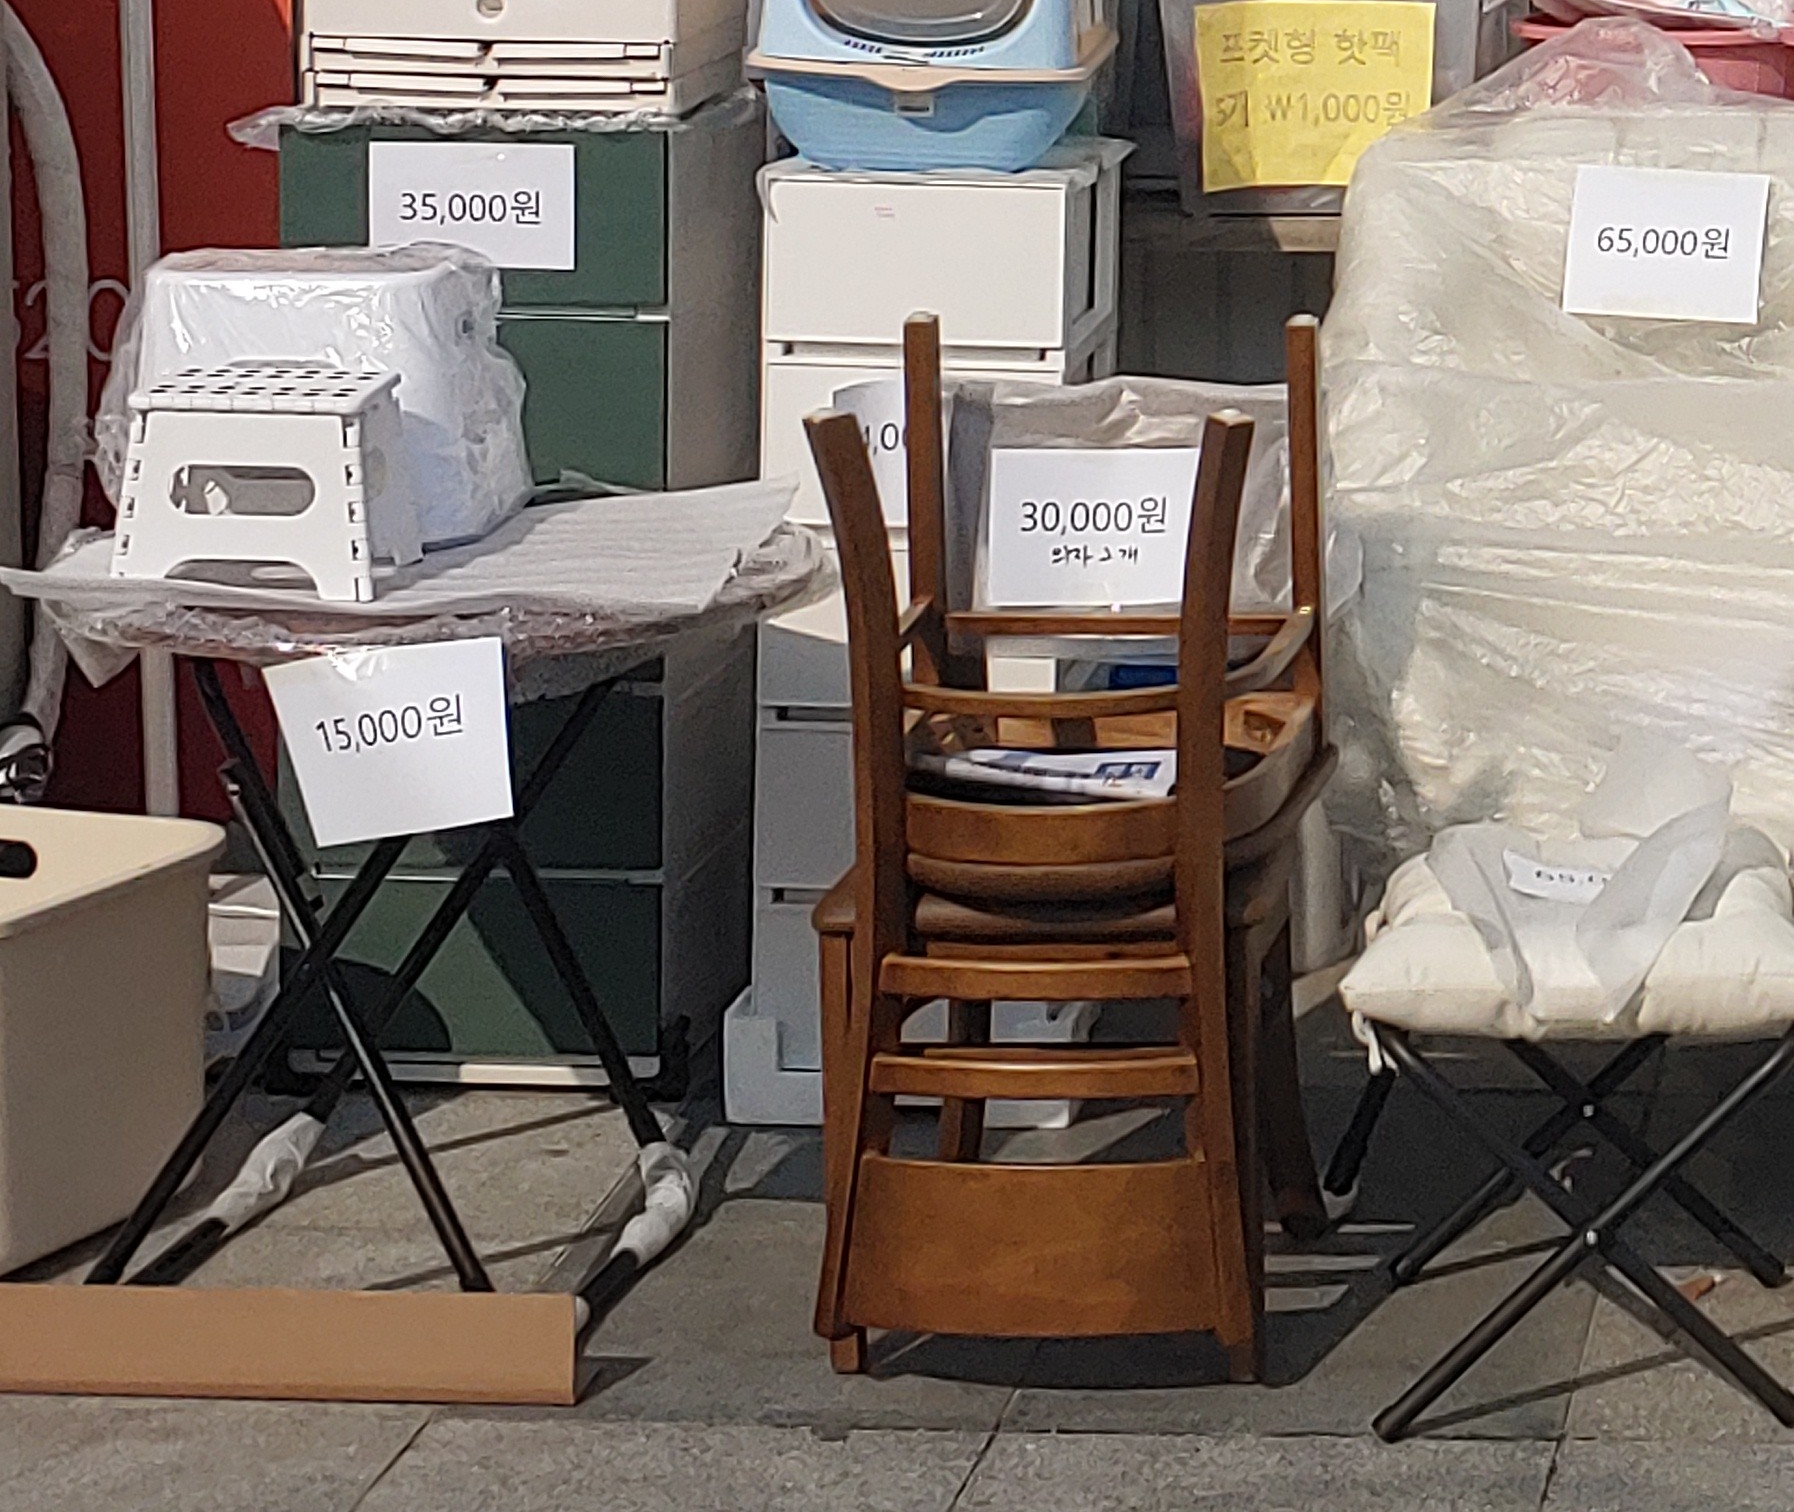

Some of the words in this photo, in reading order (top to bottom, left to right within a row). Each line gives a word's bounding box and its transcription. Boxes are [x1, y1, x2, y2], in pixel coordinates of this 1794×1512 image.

[399, 190, 542, 226] 35,000원
[1596, 226, 1731, 260] 65,000원
[1020, 496, 1167, 536] 30,000원
[315, 693, 465, 755] 15,000원
